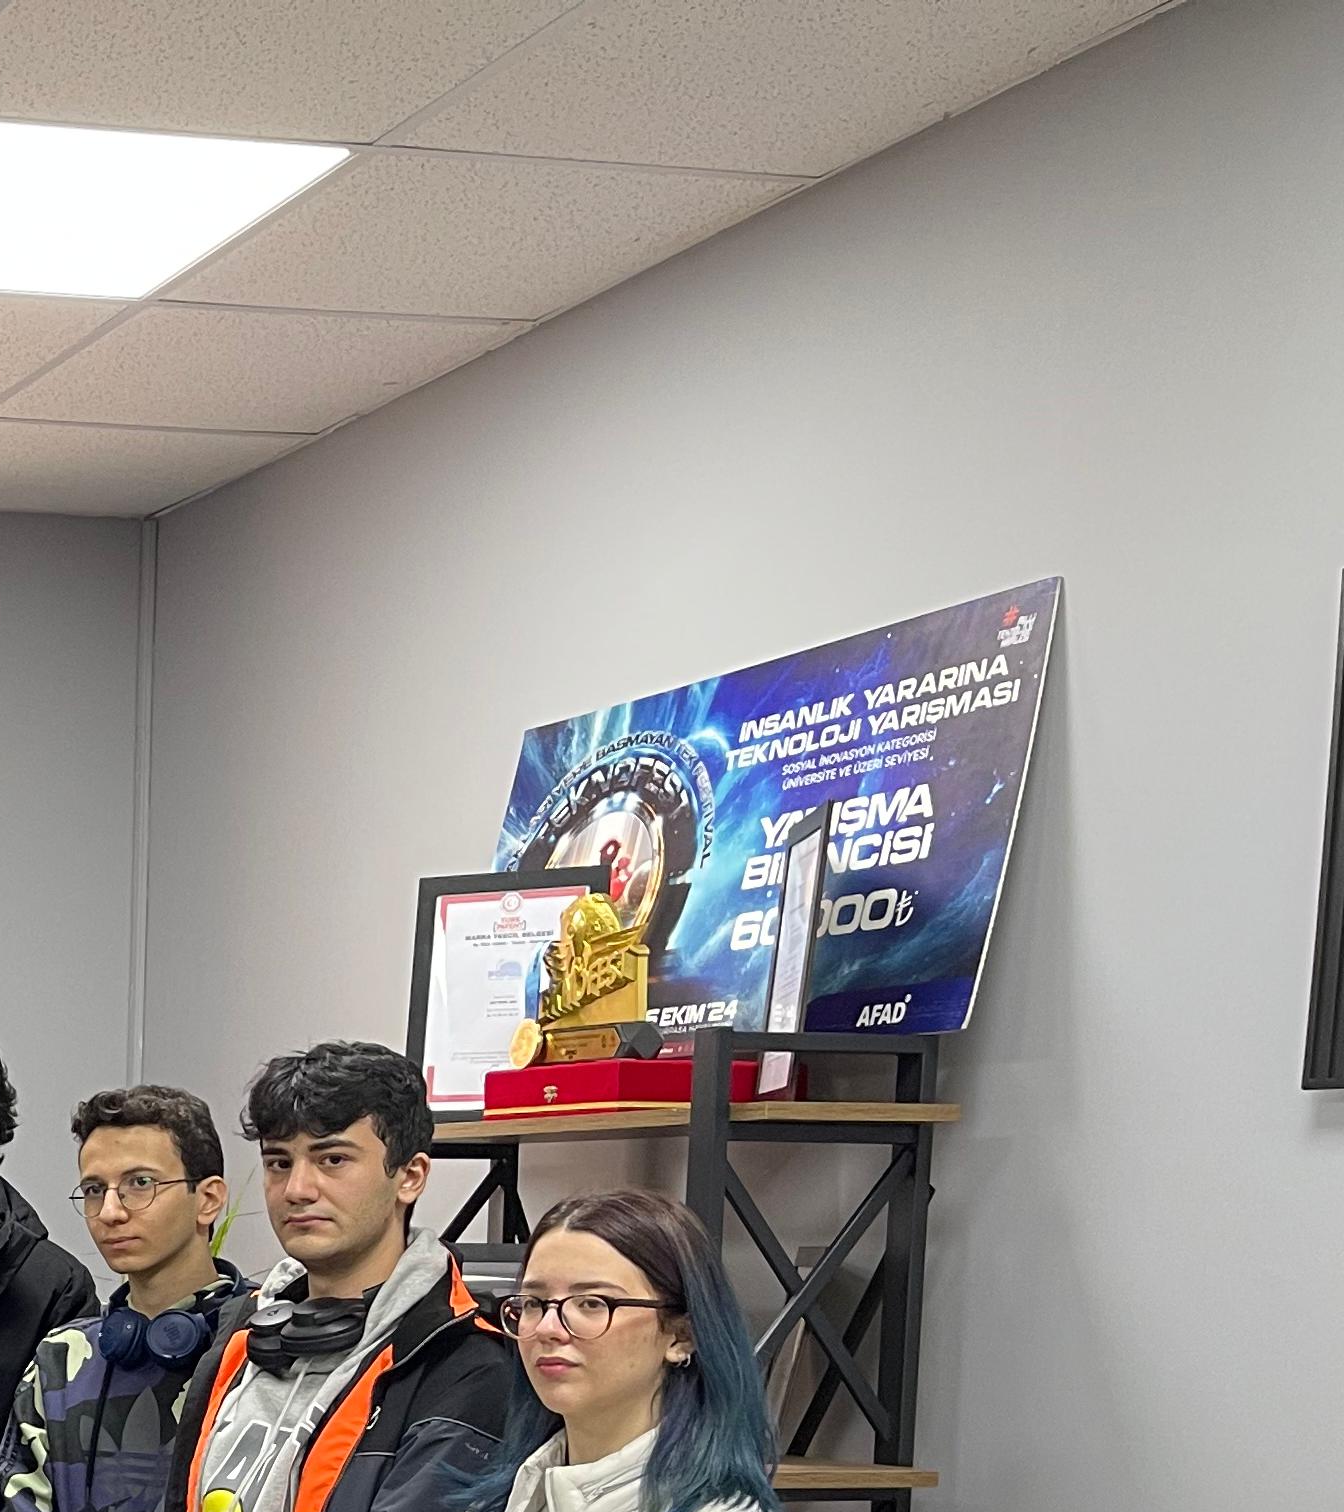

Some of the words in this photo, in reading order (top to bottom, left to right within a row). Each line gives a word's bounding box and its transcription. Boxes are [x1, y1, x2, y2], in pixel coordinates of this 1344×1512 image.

[863, 654, 1010, 711] YARARINA
[867, 678, 1022, 737] YARIŞMASI
[855, 1001, 908, 1028] AFAD
